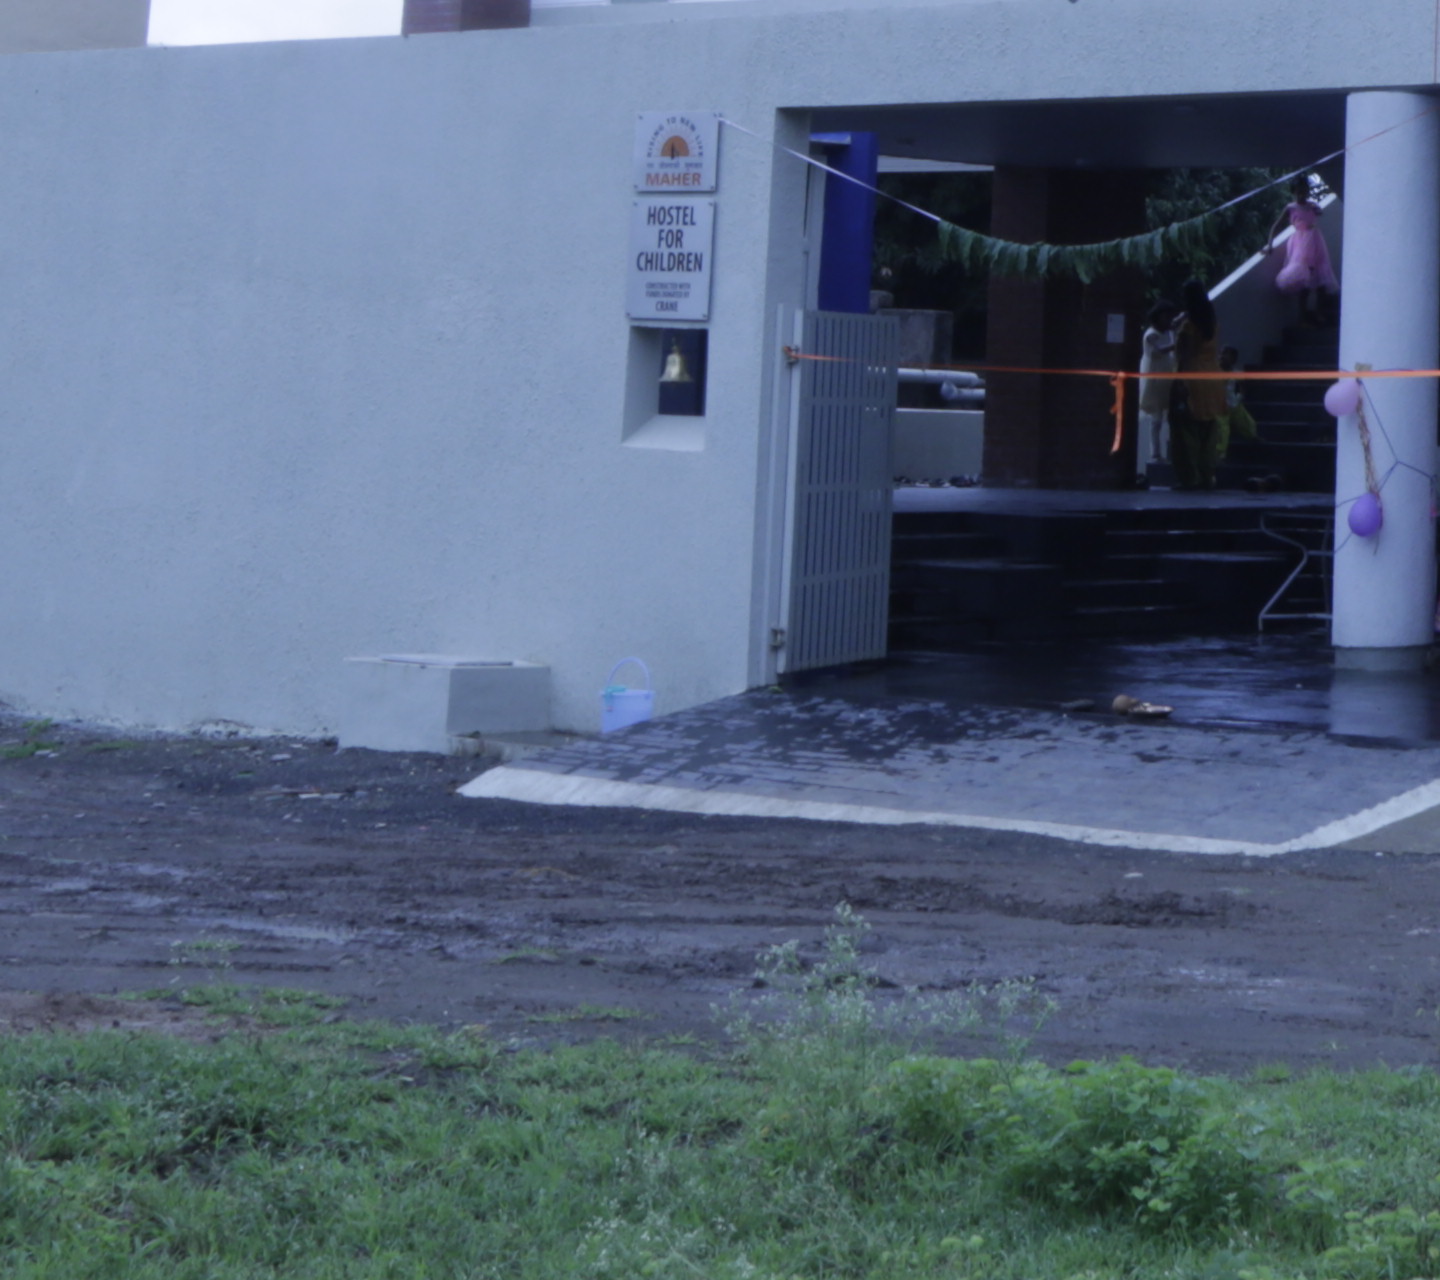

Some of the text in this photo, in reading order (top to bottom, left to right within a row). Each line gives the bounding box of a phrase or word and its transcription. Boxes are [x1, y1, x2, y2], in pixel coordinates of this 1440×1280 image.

[645, 172, 702, 187] MAHER
[647, 205, 696, 226] HOSTEL
[658, 229, 684, 249] FOR
[636, 252, 703, 272] CHILDREN
[655, 301, 678, 312] CRANE
